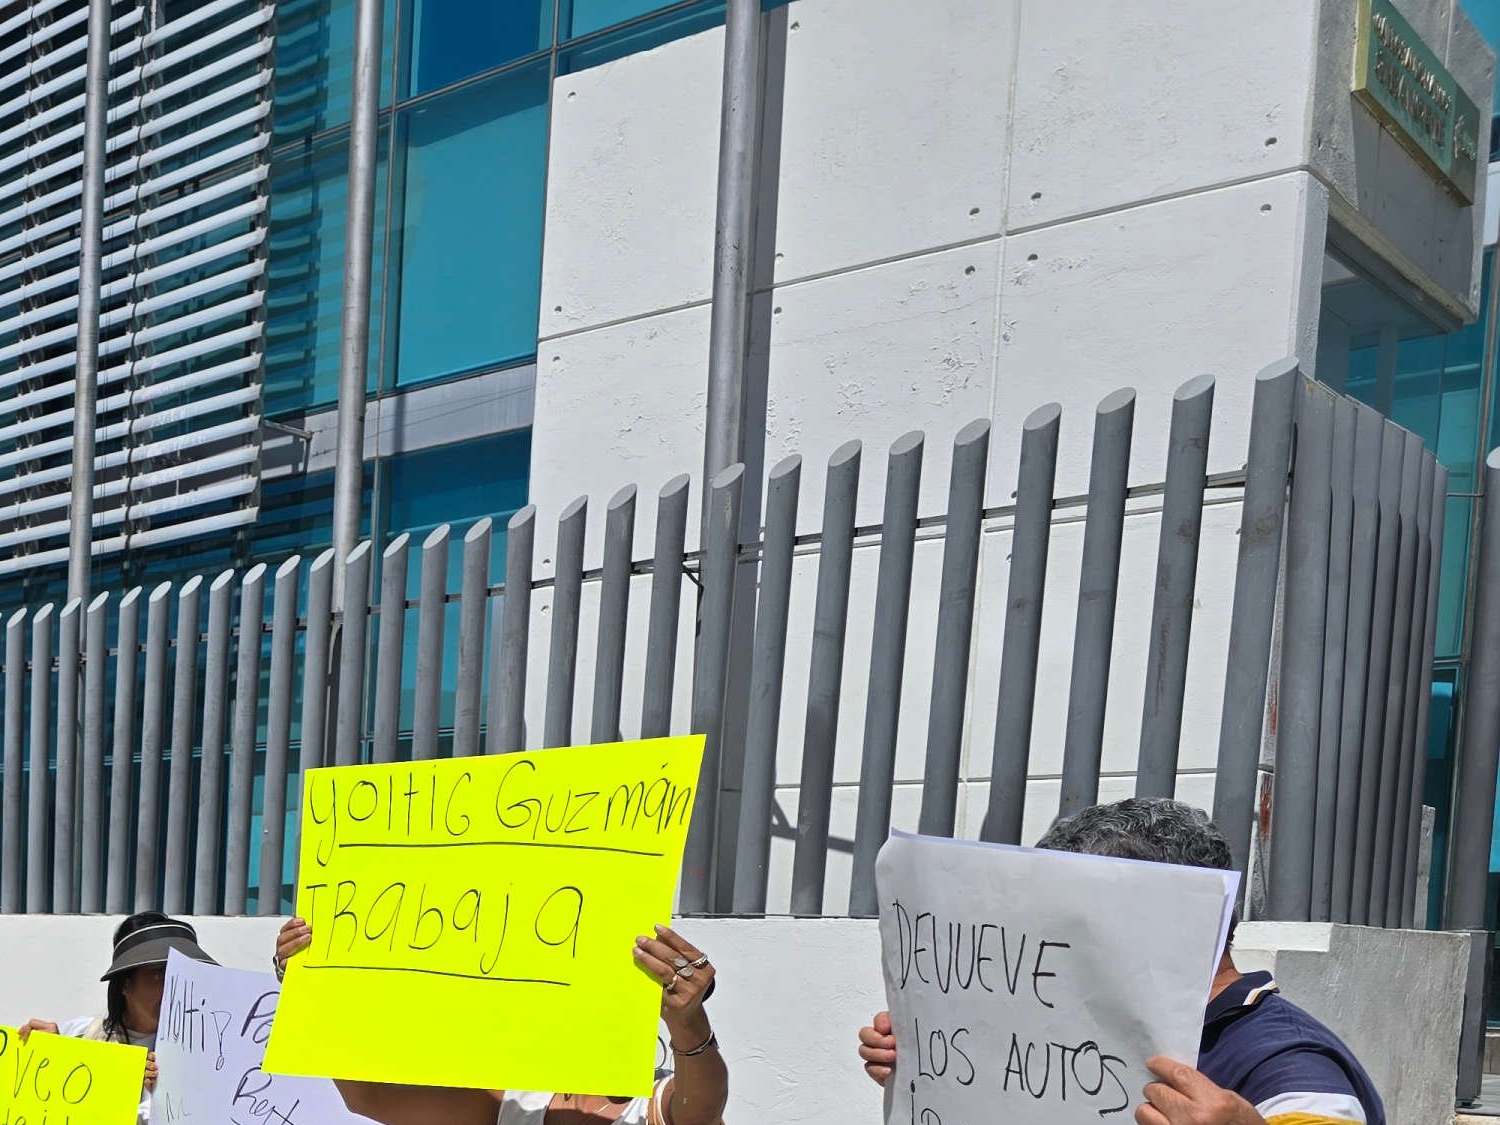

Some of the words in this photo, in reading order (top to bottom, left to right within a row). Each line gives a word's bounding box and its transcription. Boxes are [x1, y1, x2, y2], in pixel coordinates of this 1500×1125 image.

[494, 759, 692, 841] Guzmán
[914, 1017, 976, 1086] LOS
[1003, 1032, 1130, 1118] AUTOS
